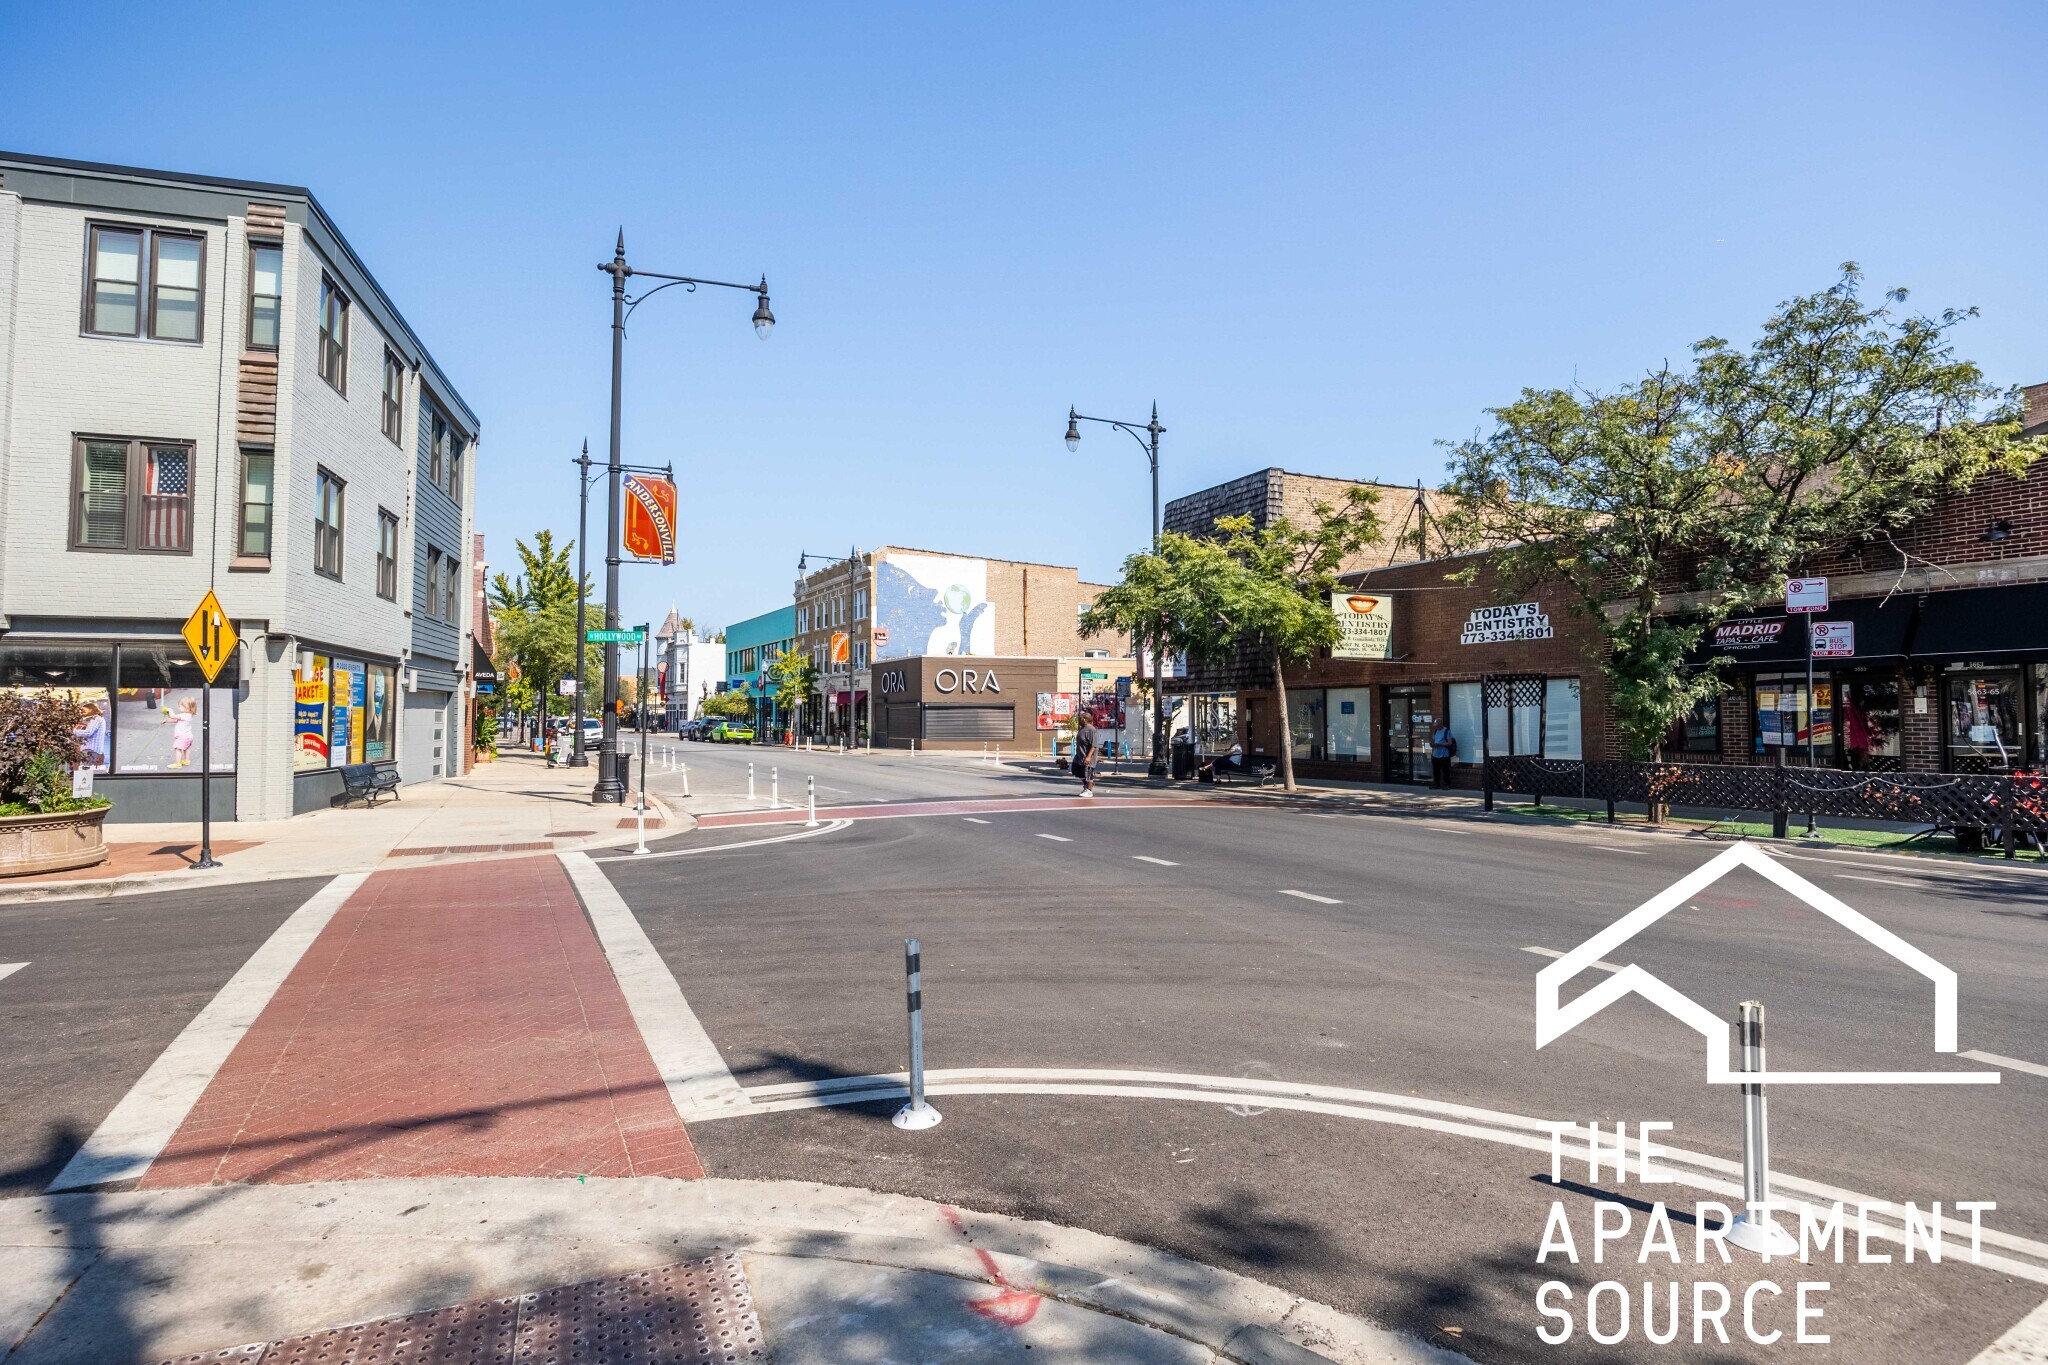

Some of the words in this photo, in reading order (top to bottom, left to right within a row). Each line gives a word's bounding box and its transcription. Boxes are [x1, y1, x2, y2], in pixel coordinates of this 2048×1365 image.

[625, 479, 673, 562] ANDERSONVILLE
[1341, 613, 1383, 621] TODAY'S
[1474, 604, 1537, 620] TODAY'S
[1466, 615, 1546, 632] DENTISTRY
[1716, 623, 1782, 637] MADRID
[594, 632, 636, 641] HOLLYWOOD
[1716, 636, 1742, 645] TAPAS
[1751, 635, 1776, 643] CAFE
[881, 670, 905, 693] ORA
[935, 669, 1001, 692] ORA
[1967, 688, 2000, 696] 5663-65
